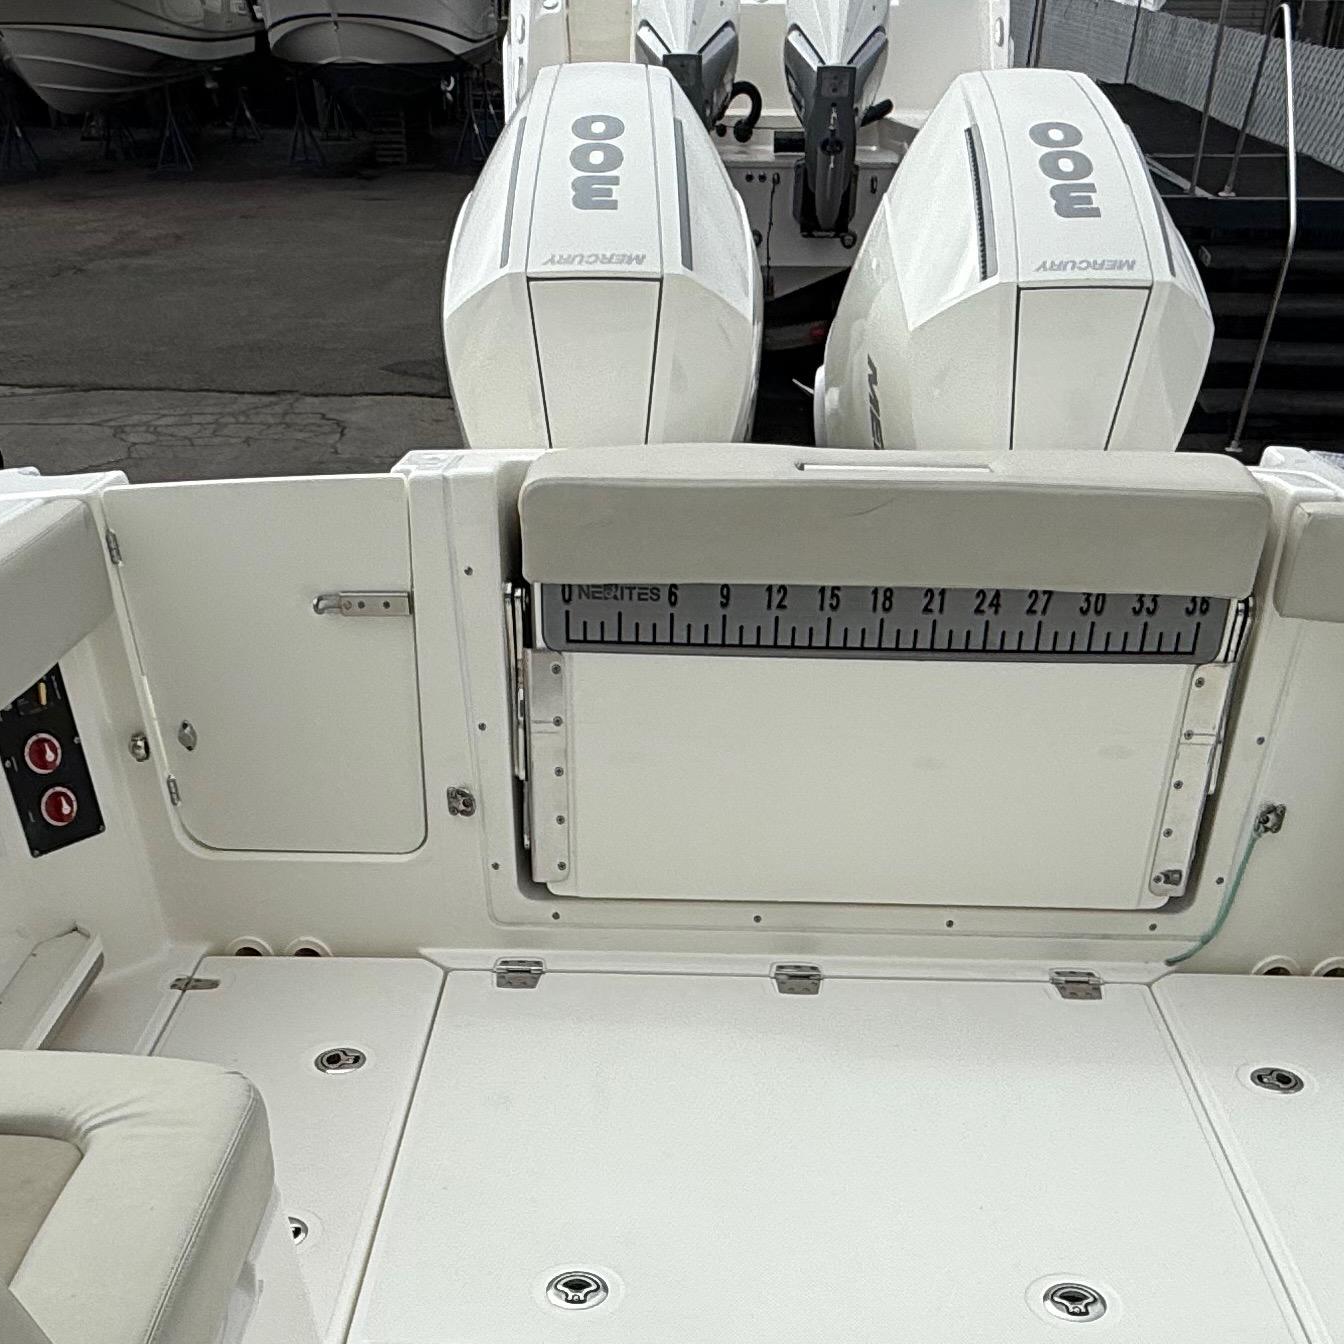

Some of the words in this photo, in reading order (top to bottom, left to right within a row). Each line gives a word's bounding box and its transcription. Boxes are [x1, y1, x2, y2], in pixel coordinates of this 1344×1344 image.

[569, 114, 625, 211] 300
[1028, 121, 1102, 219] 300
[542, 252, 647, 266] MERCURY
[1034, 258, 1137, 272] MERCURY
[560, 583, 573, 604] 0
[668, 583, 679, 608] 6
[720, 583, 731, 609] 9
[766, 584, 788, 610] 12
[818, 585, 842, 611] 15
[871, 587, 895, 613] 18
[922, 588, 947, 615] 21
[974, 589, 1002, 615] 24
[1026, 589, 1055, 616] 27
[1079, 592, 1106, 616] 30
[1132, 593, 1160, 616] 33
[1185, 595, 1211, 617] 36
